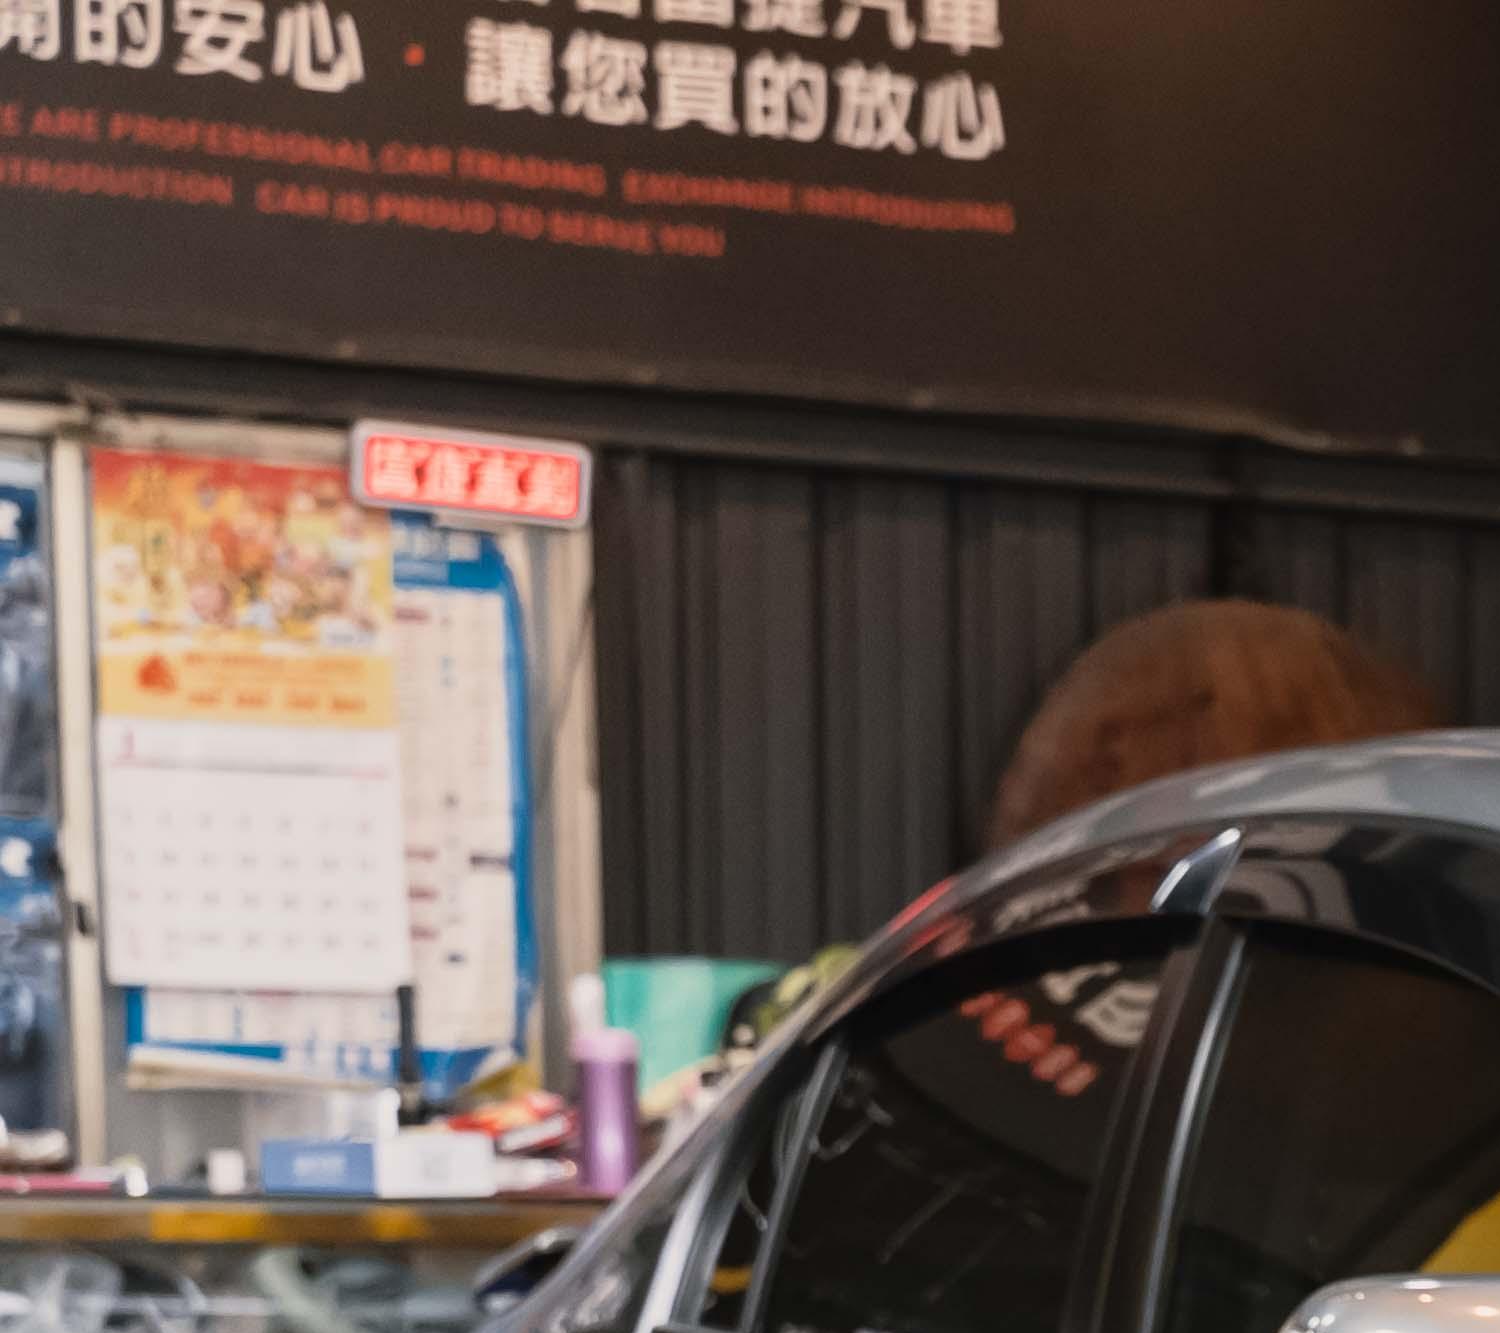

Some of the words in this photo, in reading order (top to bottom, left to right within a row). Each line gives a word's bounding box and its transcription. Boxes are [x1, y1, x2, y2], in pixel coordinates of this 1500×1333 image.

[465, 16, 1006, 160] 讓您買的放心
